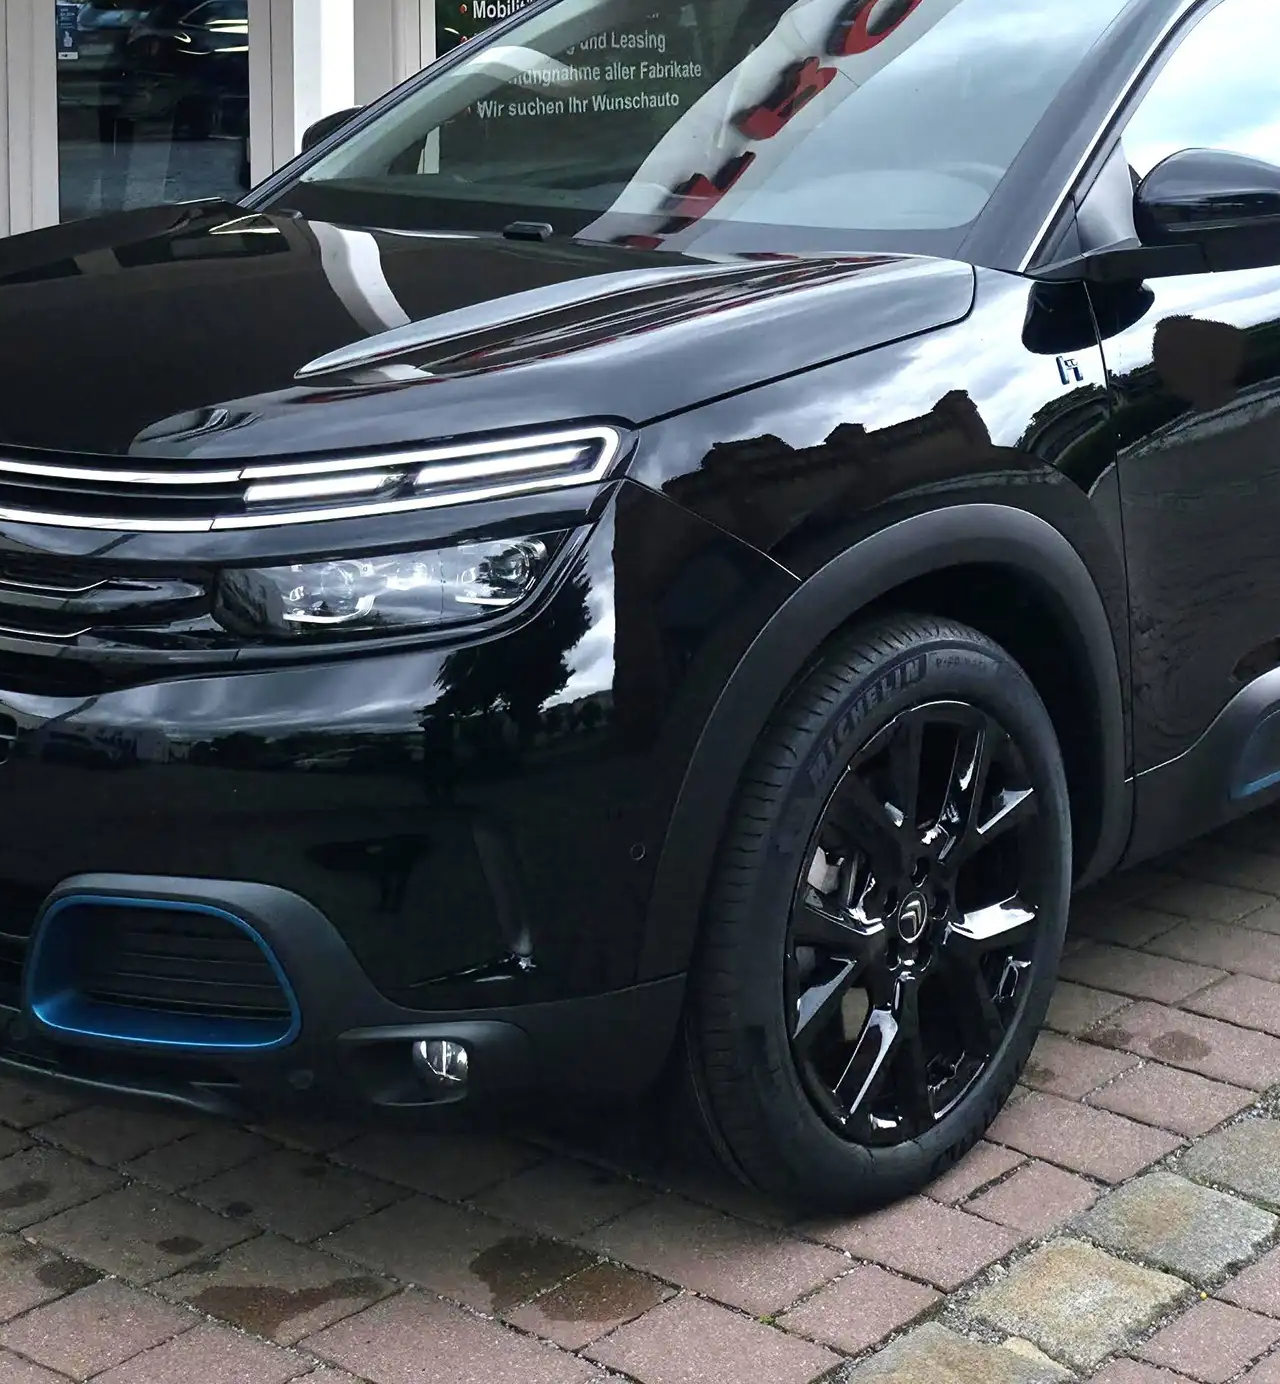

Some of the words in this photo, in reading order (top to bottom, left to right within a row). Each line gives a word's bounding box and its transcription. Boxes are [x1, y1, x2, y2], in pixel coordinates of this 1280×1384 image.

[611, 28, 666, 53] Leasing
[605, 61, 636, 80] aller
[640, 60, 702, 80] Fabrikate
[477, 99, 504, 118] Wir
[508, 96, 565, 116] suchen
[568, 95, 588, 114] Ihr
[591, 91, 680, 112] Wunschauto
